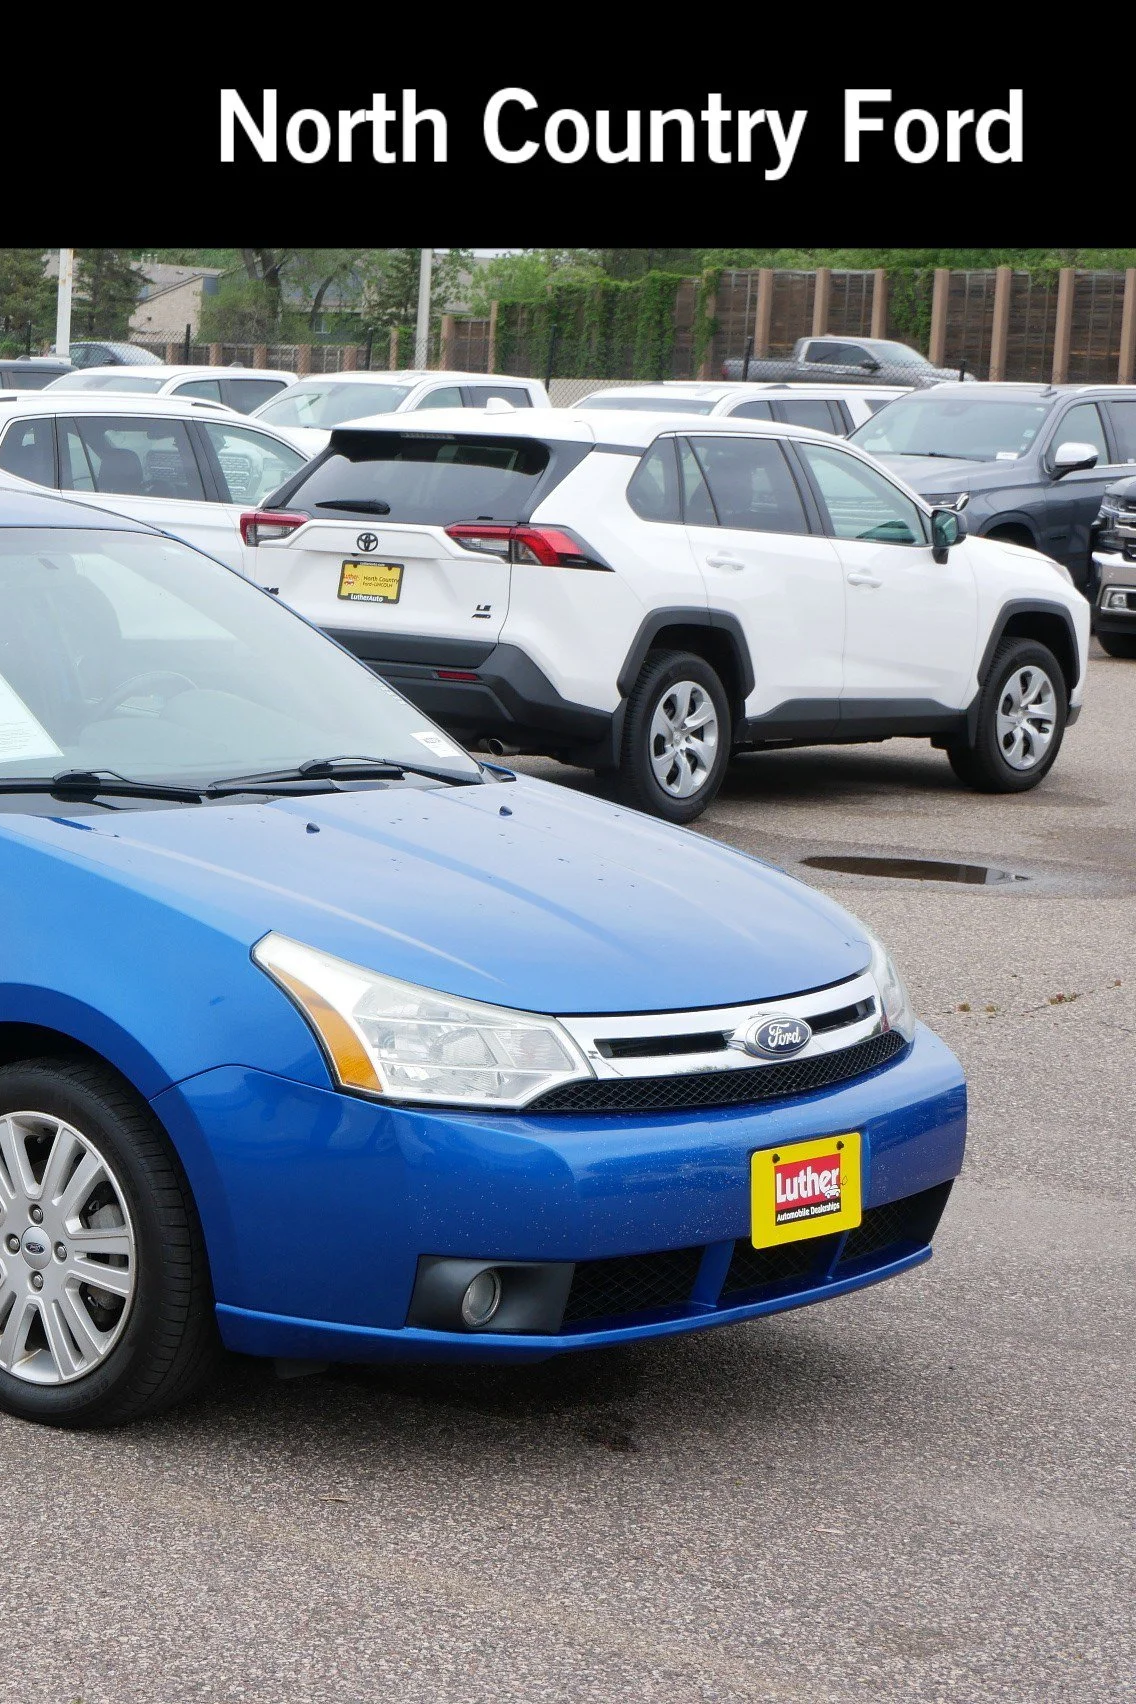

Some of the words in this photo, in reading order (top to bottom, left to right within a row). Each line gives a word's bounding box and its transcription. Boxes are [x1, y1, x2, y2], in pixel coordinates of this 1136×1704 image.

[350, 594, 383, 602] LutherAuto
[768, 1023, 801, 1048] Ford
[776, 1166, 839, 1204] Luther
[776, 1208, 809, 1222] Automobile
[810, 1202, 840, 1214] Dealerships
